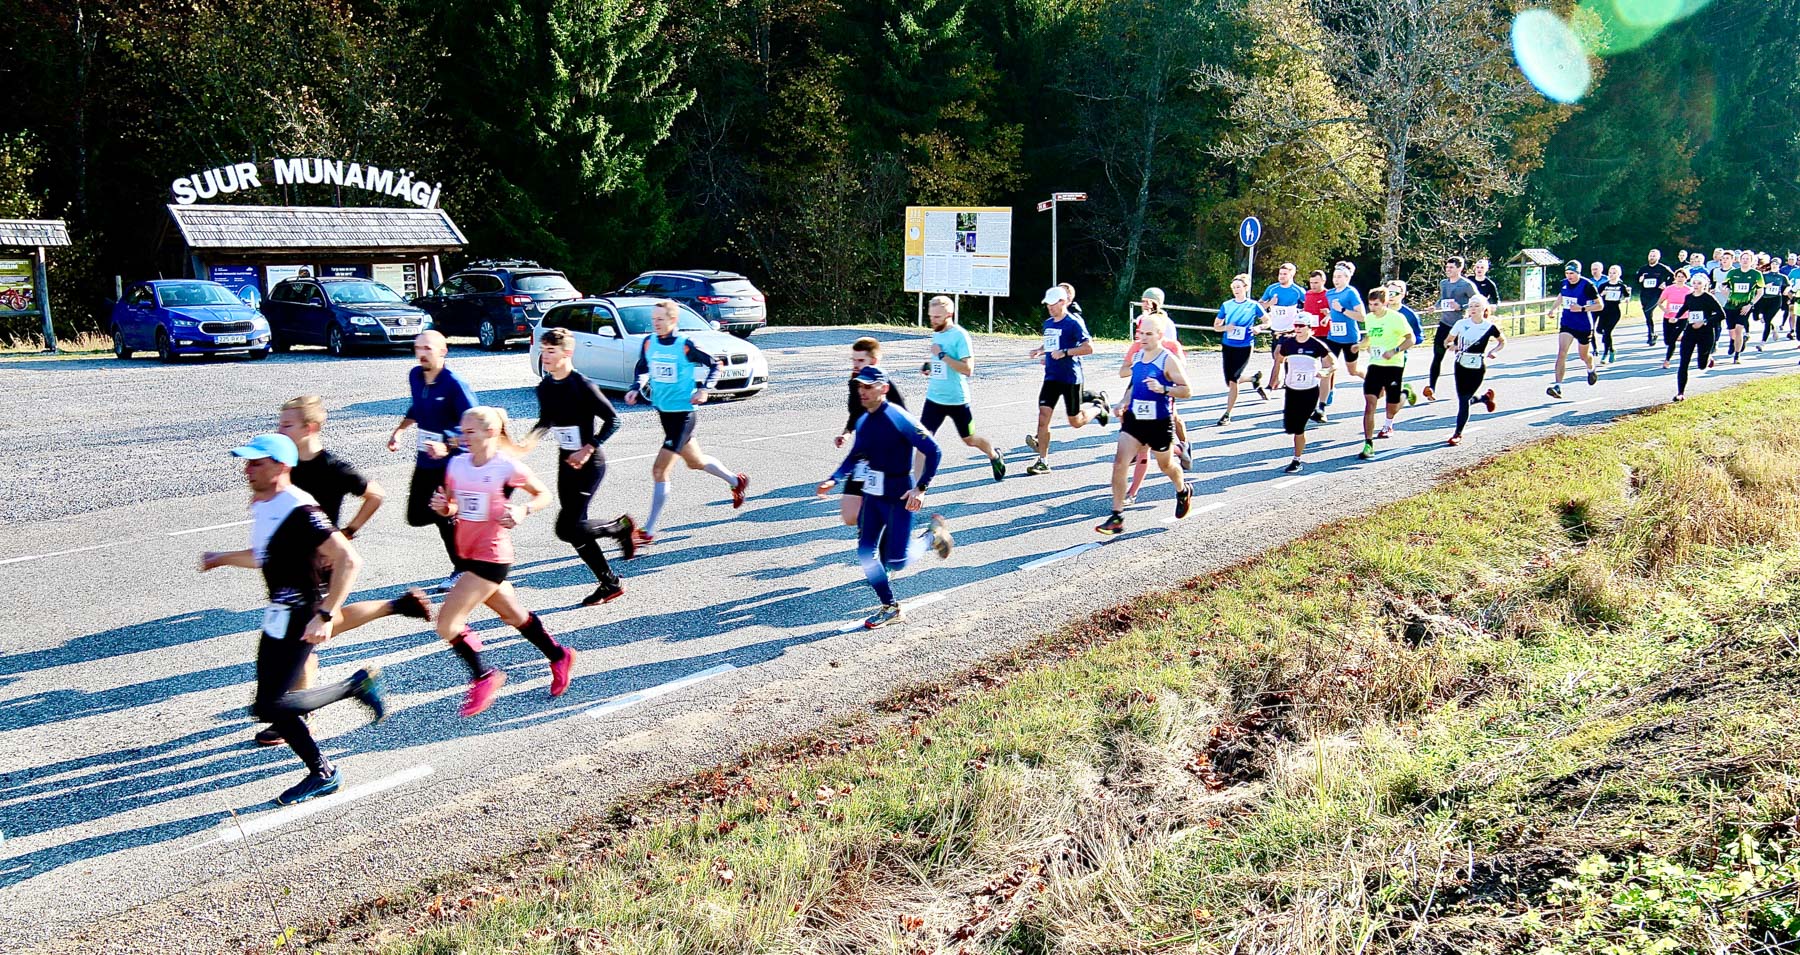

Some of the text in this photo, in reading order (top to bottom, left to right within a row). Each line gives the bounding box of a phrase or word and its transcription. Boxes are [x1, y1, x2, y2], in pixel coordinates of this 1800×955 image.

[172, 162, 261, 205] SUUR
[1296, 373, 1307, 382] 21
[1138, 404, 1150, 413] 64
